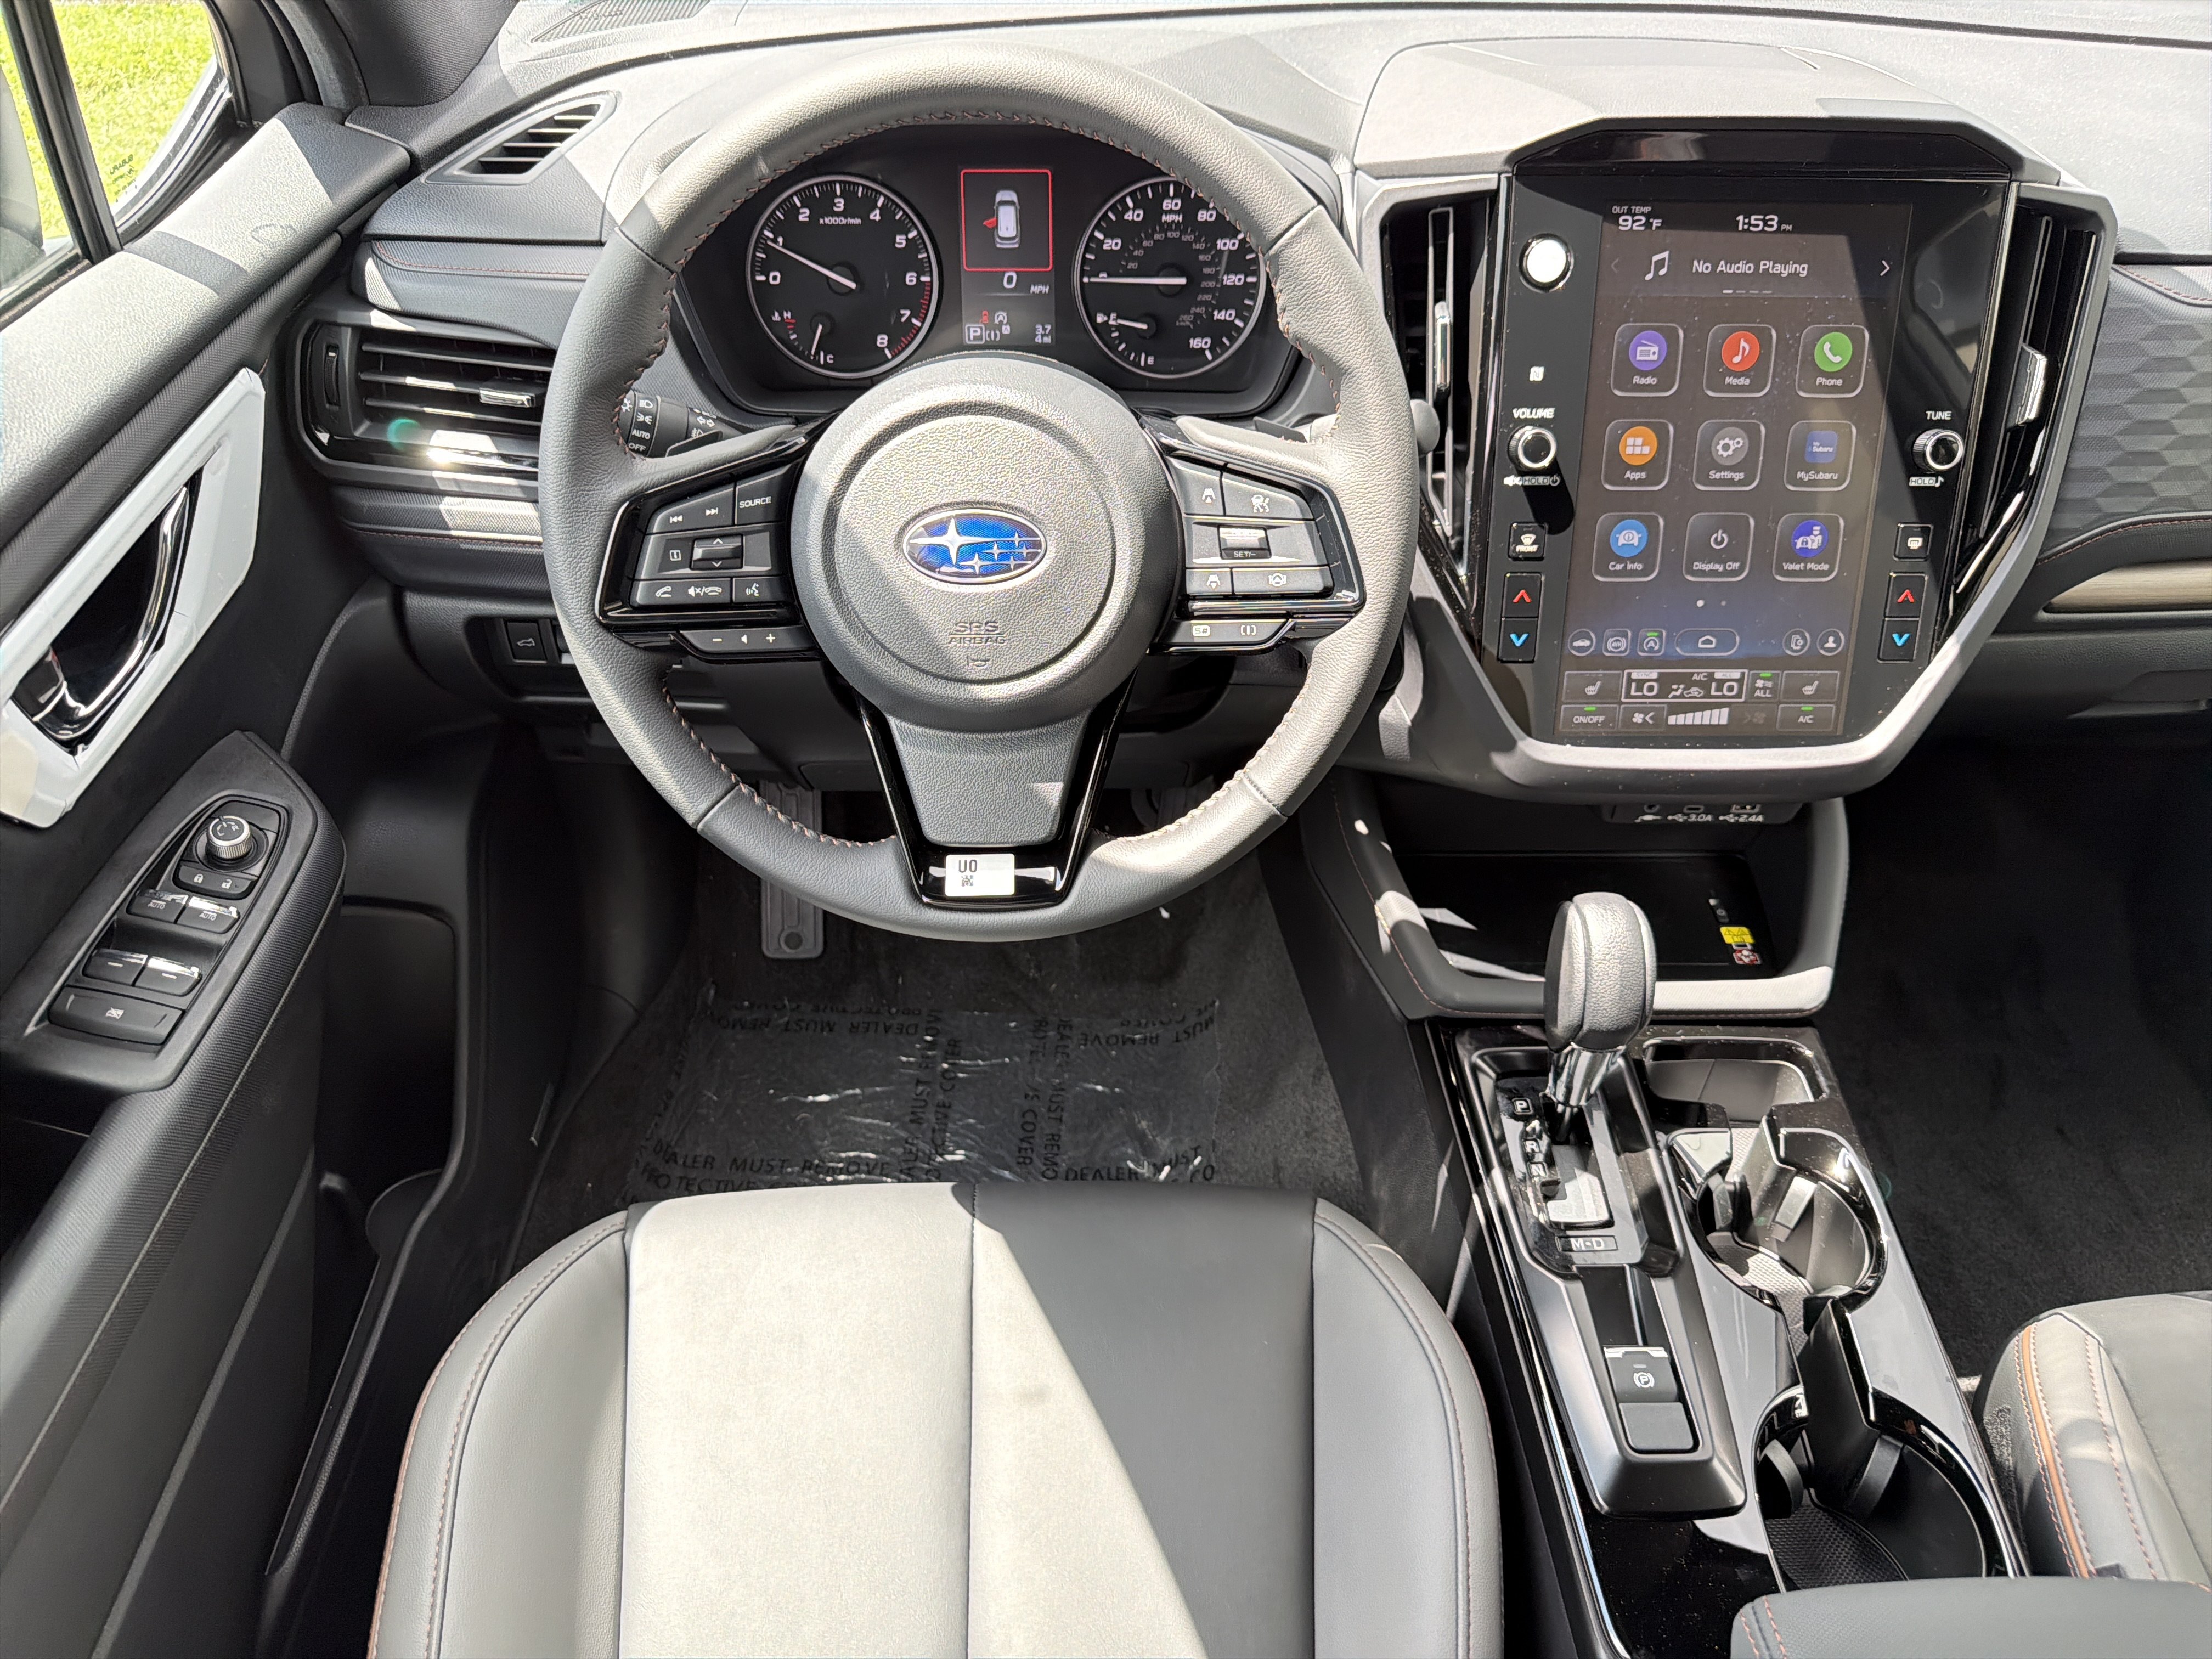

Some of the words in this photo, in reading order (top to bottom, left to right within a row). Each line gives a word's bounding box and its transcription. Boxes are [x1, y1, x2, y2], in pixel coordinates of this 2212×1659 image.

[834, 198, 844, 211] 3
[1163, 198, 1182, 211] 60
[1612, 206, 1629, 214] OUT
[1630, 206, 1651, 214] TEMP
[798, 208, 810, 222] 2
[869, 208, 881, 222] 4
[1124, 209, 1144, 222] 40
[1161, 213, 1183, 223] MPH
[1197, 209, 1217, 222] 80
[1618, 215, 1646, 231] 92
[1736, 215, 1779, 232] 1:53
[1167, 230, 1180, 239] 100
[1181, 234, 1195, 242] 120
[777, 236, 783, 246] 1
[895, 235, 906, 249] 5
[1103, 238, 1122, 251] 20
[1216, 238, 1239, 251] 100
[1692, 259, 1712, 274] No
[1717, 259, 1754, 275] Audio
[1759, 259, 1808, 278] Playing
[769, 272, 781, 285] 0
[905, 272, 917, 285] 6
[1003, 272, 1017, 289] 0
[1030, 284, 1049, 294] MPH
[1222, 273, 1244, 286] 120
[783, 311, 791, 319] H
[900, 309, 911, 323] 7
[1213, 308, 1236, 321] 140
[876, 334, 888, 348] 8
[1189, 337, 1211, 349] 160
[826, 354, 834, 363] C
[1147, 356, 1154, 365] E
[1633, 376, 1657, 385] Radio
[1725, 376, 1750, 386] Media
[1816, 377, 1843, 386] Phone
[1513, 408, 1555, 419] VOLUME
[1925, 410, 1952, 420] TUNE
[632, 428, 651, 439] AUTO
[628, 442, 647, 452] OFF
[1523, 476, 1549, 486] HOLD
[1624, 470, 1646, 481] Apps
[1708, 470, 1745, 481] Settings
[1797, 471, 1838, 481] MySubaru
[1910, 477, 1935, 486] HOLD
[739, 496, 771, 509] SOURCE
[1516, 544, 1539, 552] FRONT
[1609, 561, 1624, 571] Car
[1626, 561, 1643, 571] Info
[1692, 561, 1724, 572] Display
[1725, 561, 1740, 571] Off
[1782, 561, 1804, 571] Valet
[1806, 561, 1830, 571] Mode
[955, 620, 999, 634] SRS
[948, 636, 1007, 645] AIRBAG
[1692, 673, 1709, 681] A/C
[1630, 681, 1660, 697] LO
[1711, 681, 1739, 696] LO
[1754, 689, 1773, 697] ALL
[1573, 715, 1606, 724] ON/OFF
[1797, 715, 1814, 724] A/C
[1688, 814, 1712, 822] 3.0A
[1738, 814, 1765, 823] 2.4A
[147, 901, 165, 910] AUTO
[199, 912, 216, 921] AUTO
[783, 1018, 836, 1034] MUST
[849, 1020, 919, 1036] DEALER
[1078, 1032, 1160, 1046] REMOVE
[1516, 1101, 1528, 1111] P
[1016, 1108, 1037, 1166] COVER
[1525, 1140, 1538, 1152] R
[729, 1156, 788, 1174] MUST
[1531, 1163, 1544, 1176] N
[1064, 1166, 1139, 1181] DEALER
